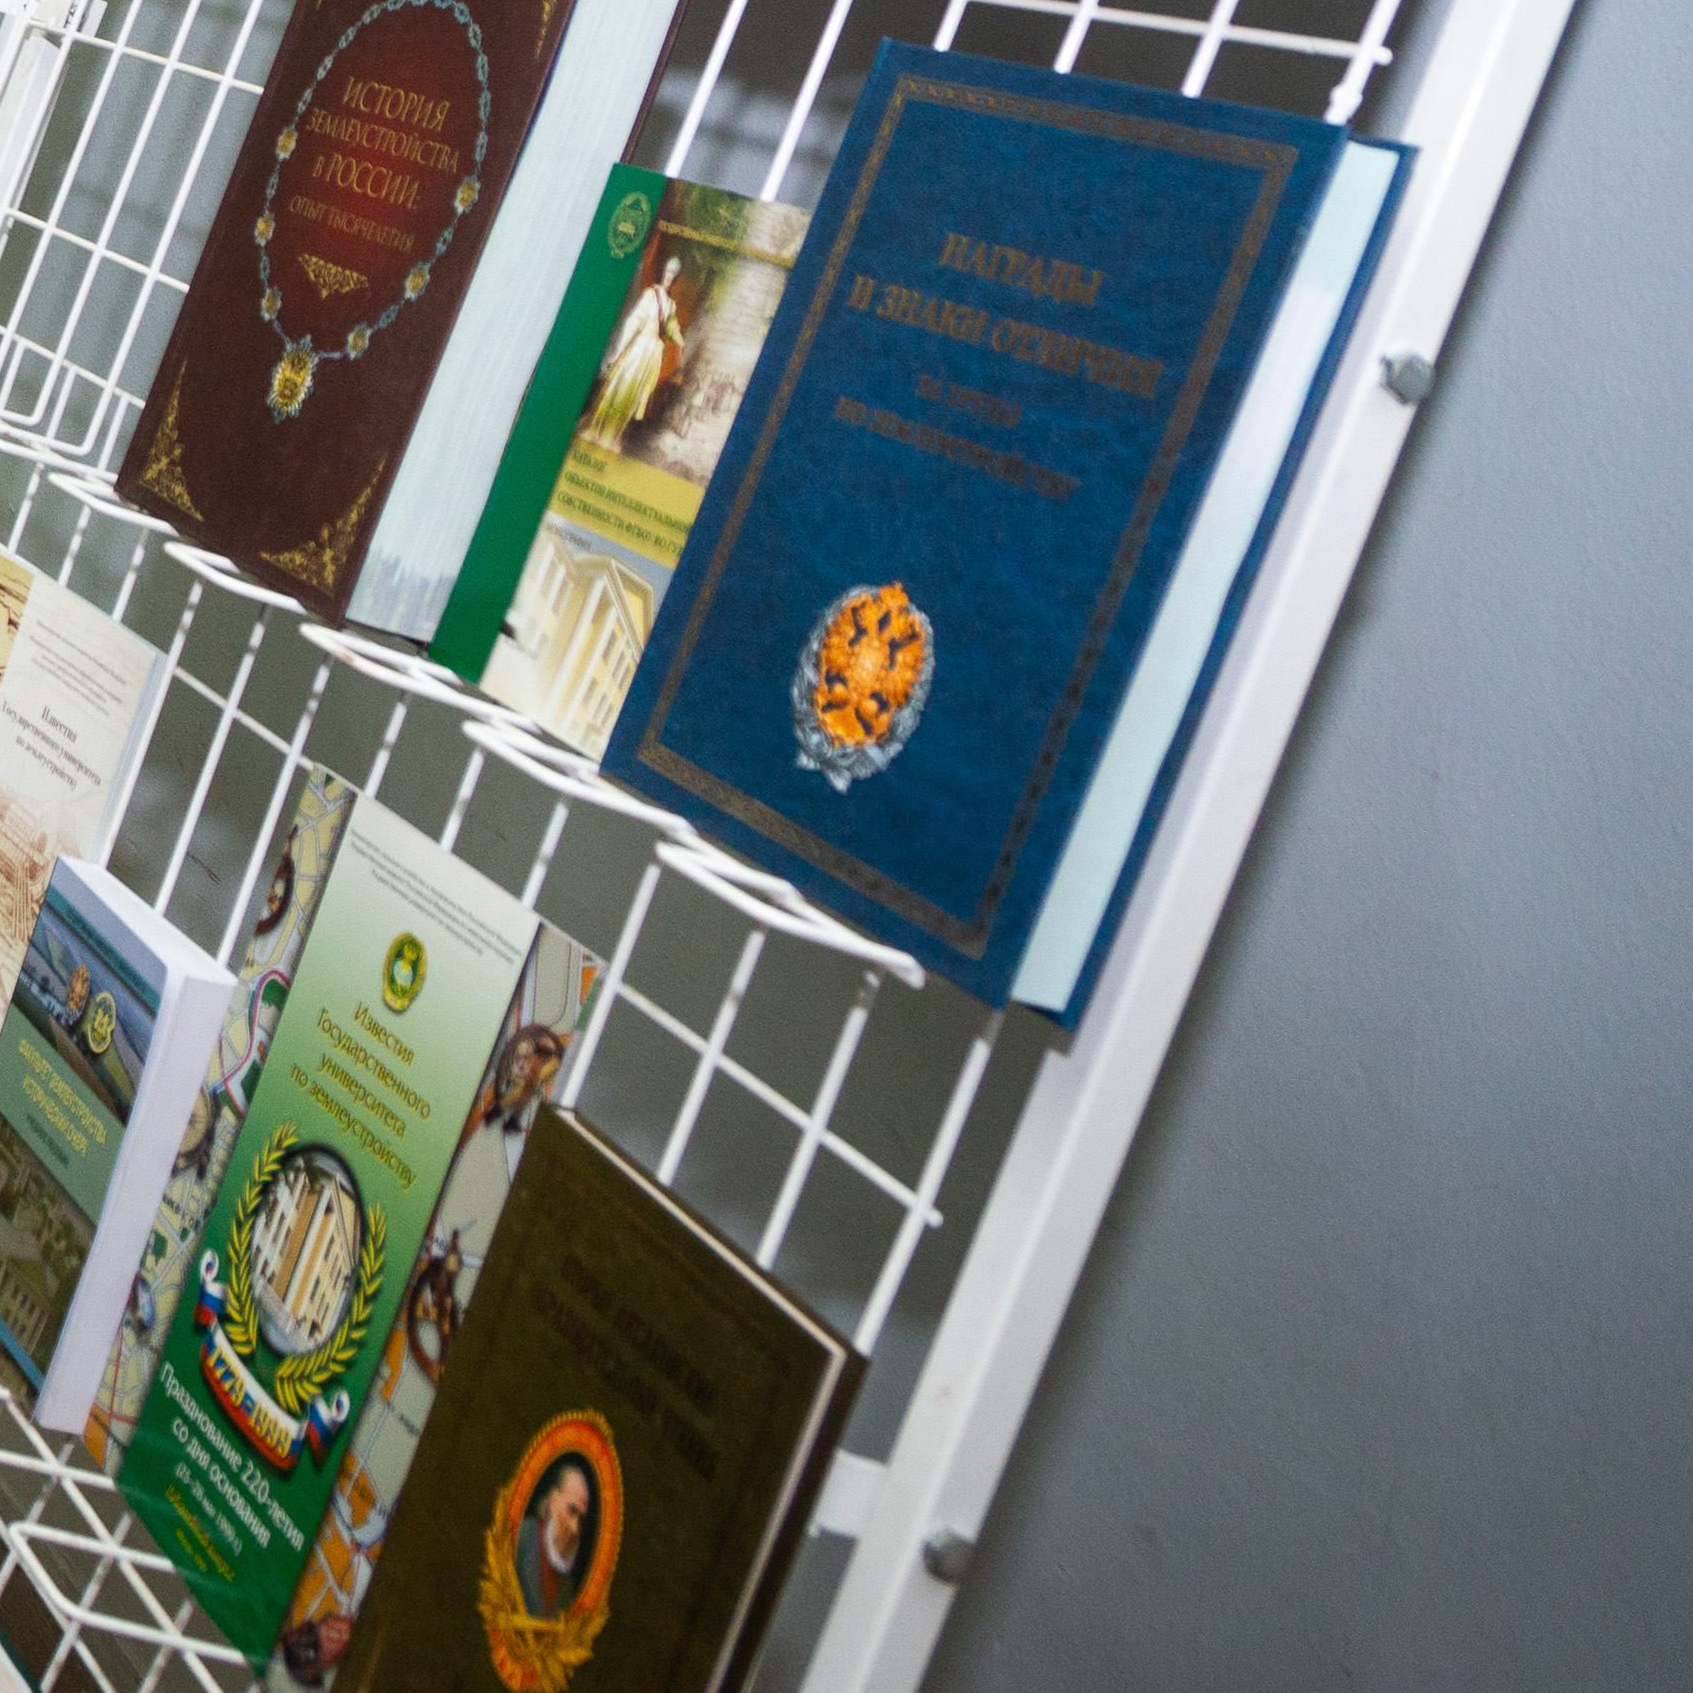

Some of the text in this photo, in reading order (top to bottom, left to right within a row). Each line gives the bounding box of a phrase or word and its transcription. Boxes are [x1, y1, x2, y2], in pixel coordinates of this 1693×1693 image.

[302, 103, 466, 177] ЗЕМЛЕУСТРОЙСТВА
[337, 75, 453, 136] ИСТОРИЯ
[309, 152, 427, 215] в РОССИИ:
[285, 192, 417, 258] ОПЫТ ТЫСЯЧЕЛЕТИЯ
[935, 231, 1107, 311] НАГРАДЫ
[874, 283, 991, 348] ЗНАКИ
[984, 315, 1167, 402] ОТЛИЧИЯ
[39, 705, 80, 743] Известия
[312, 1005, 435, 1128] Государственного
[351, 999, 418, 1071] Известия
[288, 1059, 421, 1196] по землеустройству
[315, 1045, 410, 1146] университета
[157, 1358, 309, 1561] Празднование 220-летия
[167, 1408, 273, 1555] со дня основания
